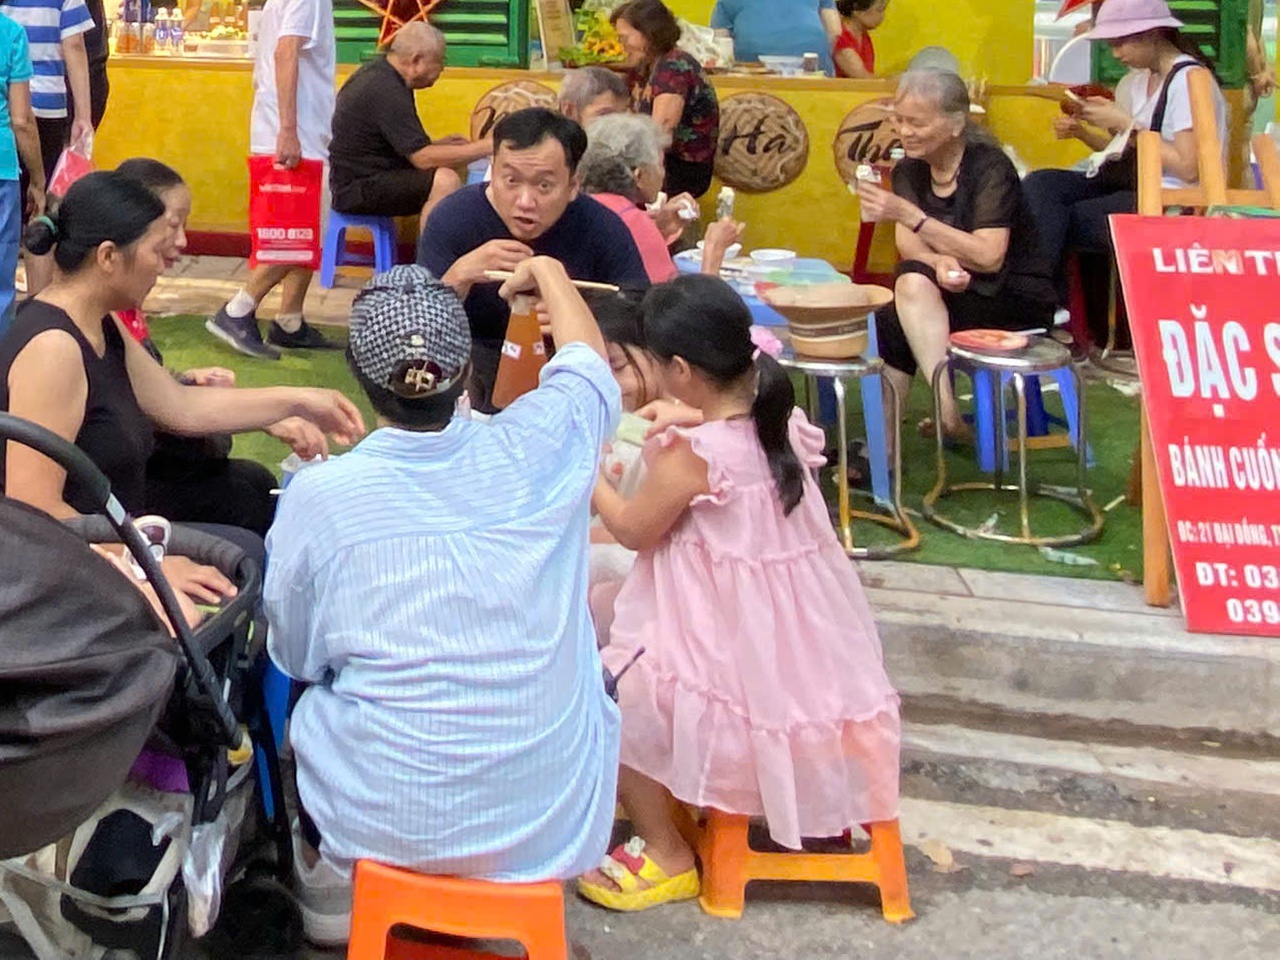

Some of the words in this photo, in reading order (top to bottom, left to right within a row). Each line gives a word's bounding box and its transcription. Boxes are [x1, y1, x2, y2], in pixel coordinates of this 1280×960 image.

[1158, 303, 1258, 418] ĐẶC
[1167, 435, 1230, 489] BÁNH
[1195, 561, 1240, 588] ĐT:
